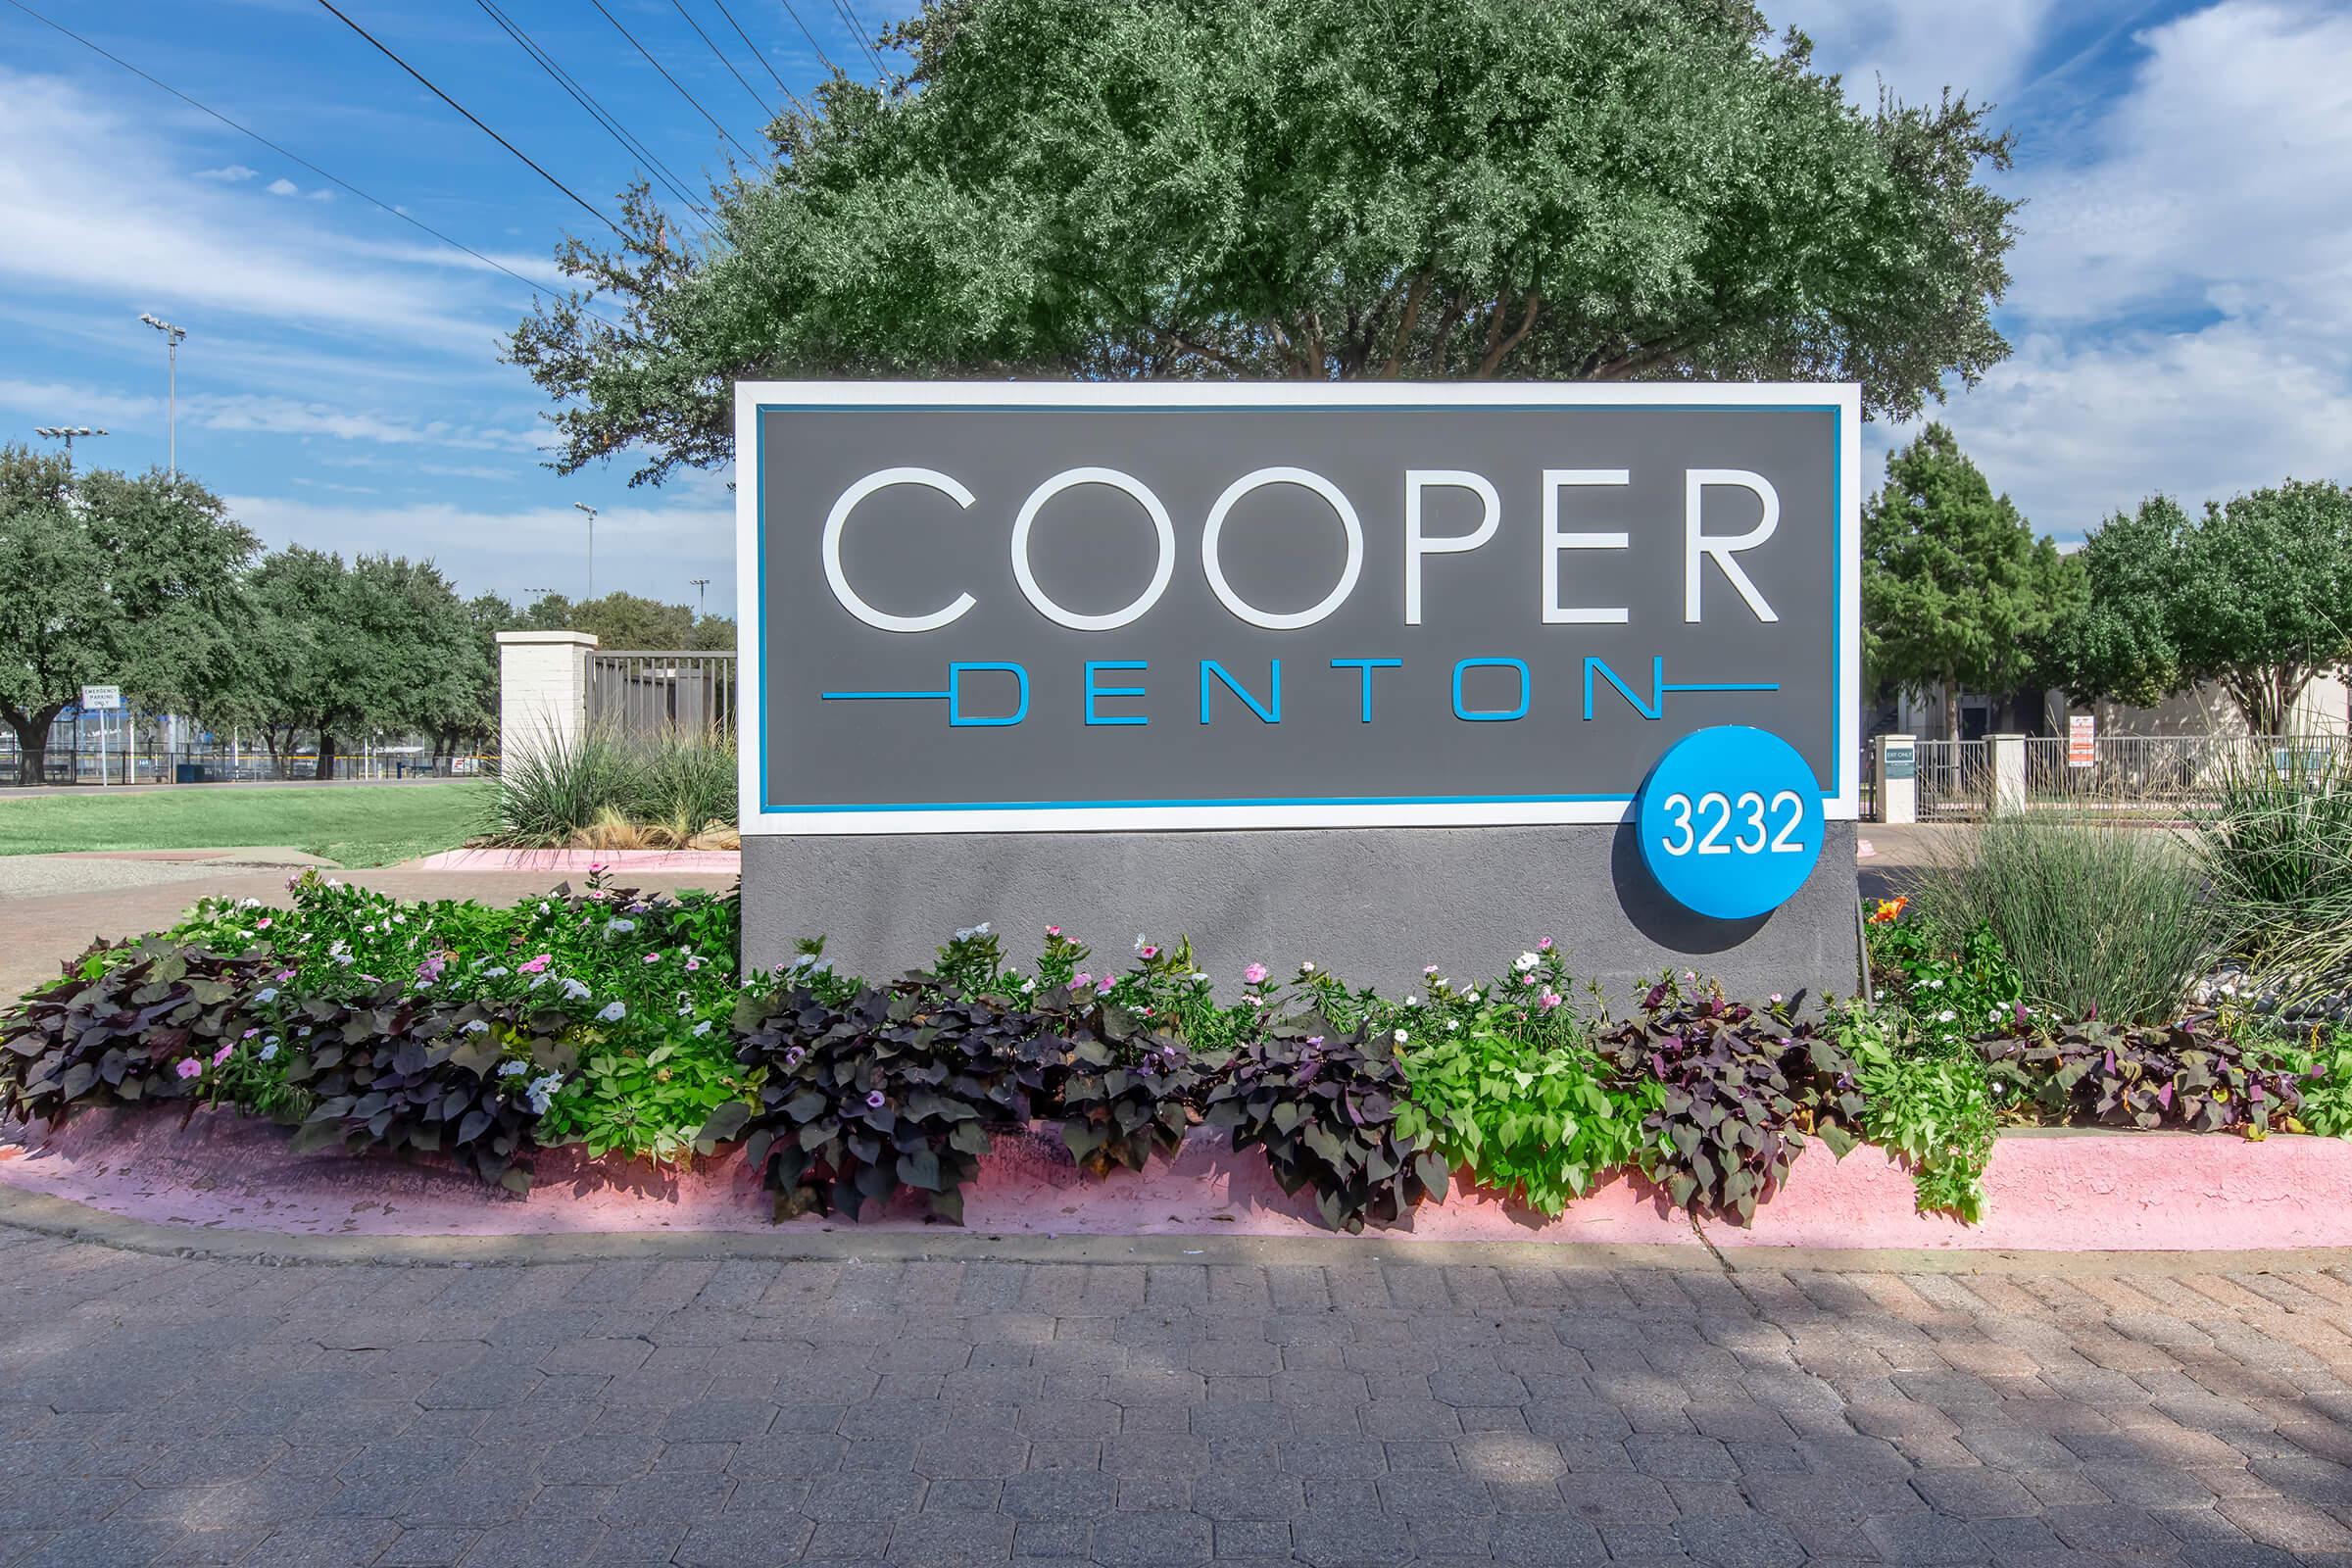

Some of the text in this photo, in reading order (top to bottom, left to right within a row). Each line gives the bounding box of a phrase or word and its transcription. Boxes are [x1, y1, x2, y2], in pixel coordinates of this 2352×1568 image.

[822, 466, 1780, 632] COOPER
[948, 656, 1665, 727] DENTON
[1662, 791, 1803, 857] 3232
